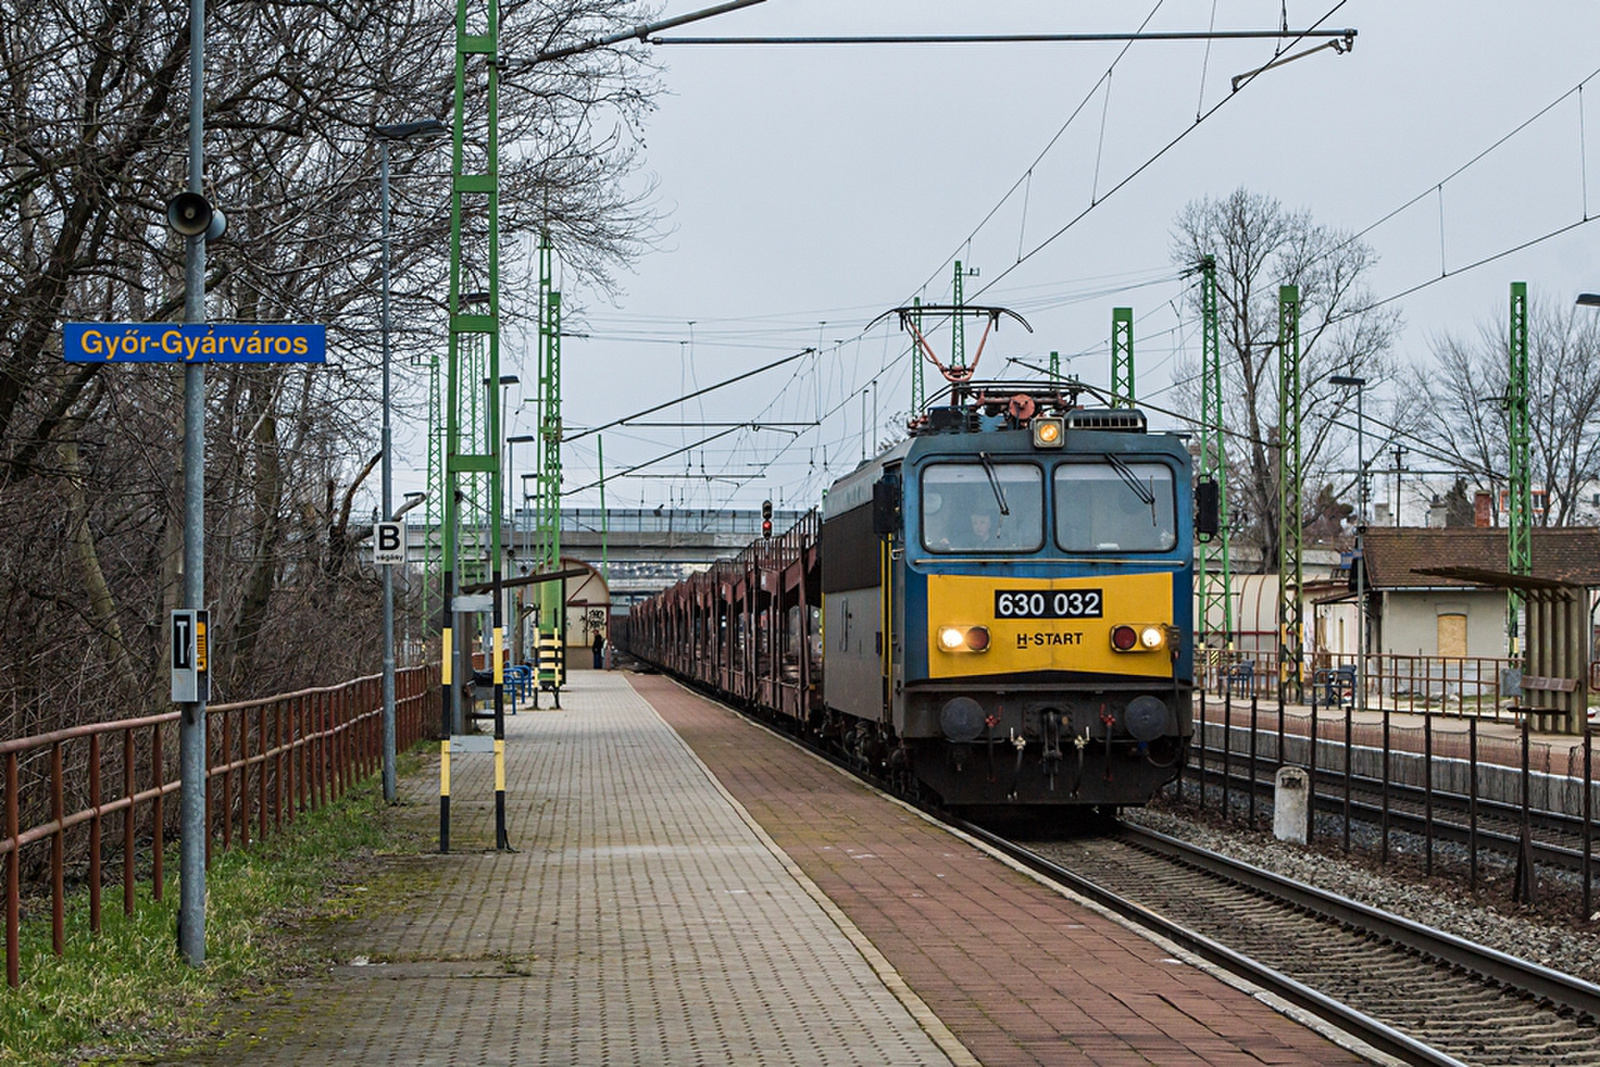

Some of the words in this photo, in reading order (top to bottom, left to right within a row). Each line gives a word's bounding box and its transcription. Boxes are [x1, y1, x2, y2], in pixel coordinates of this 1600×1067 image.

[81, 329, 309, 360] Győr-Gyárváros
[378, 525, 401, 551] B
[999, 593, 1045, 616] 630
[1053, 592, 1100, 615] 032
[1017, 632, 1083, 649] H-START
